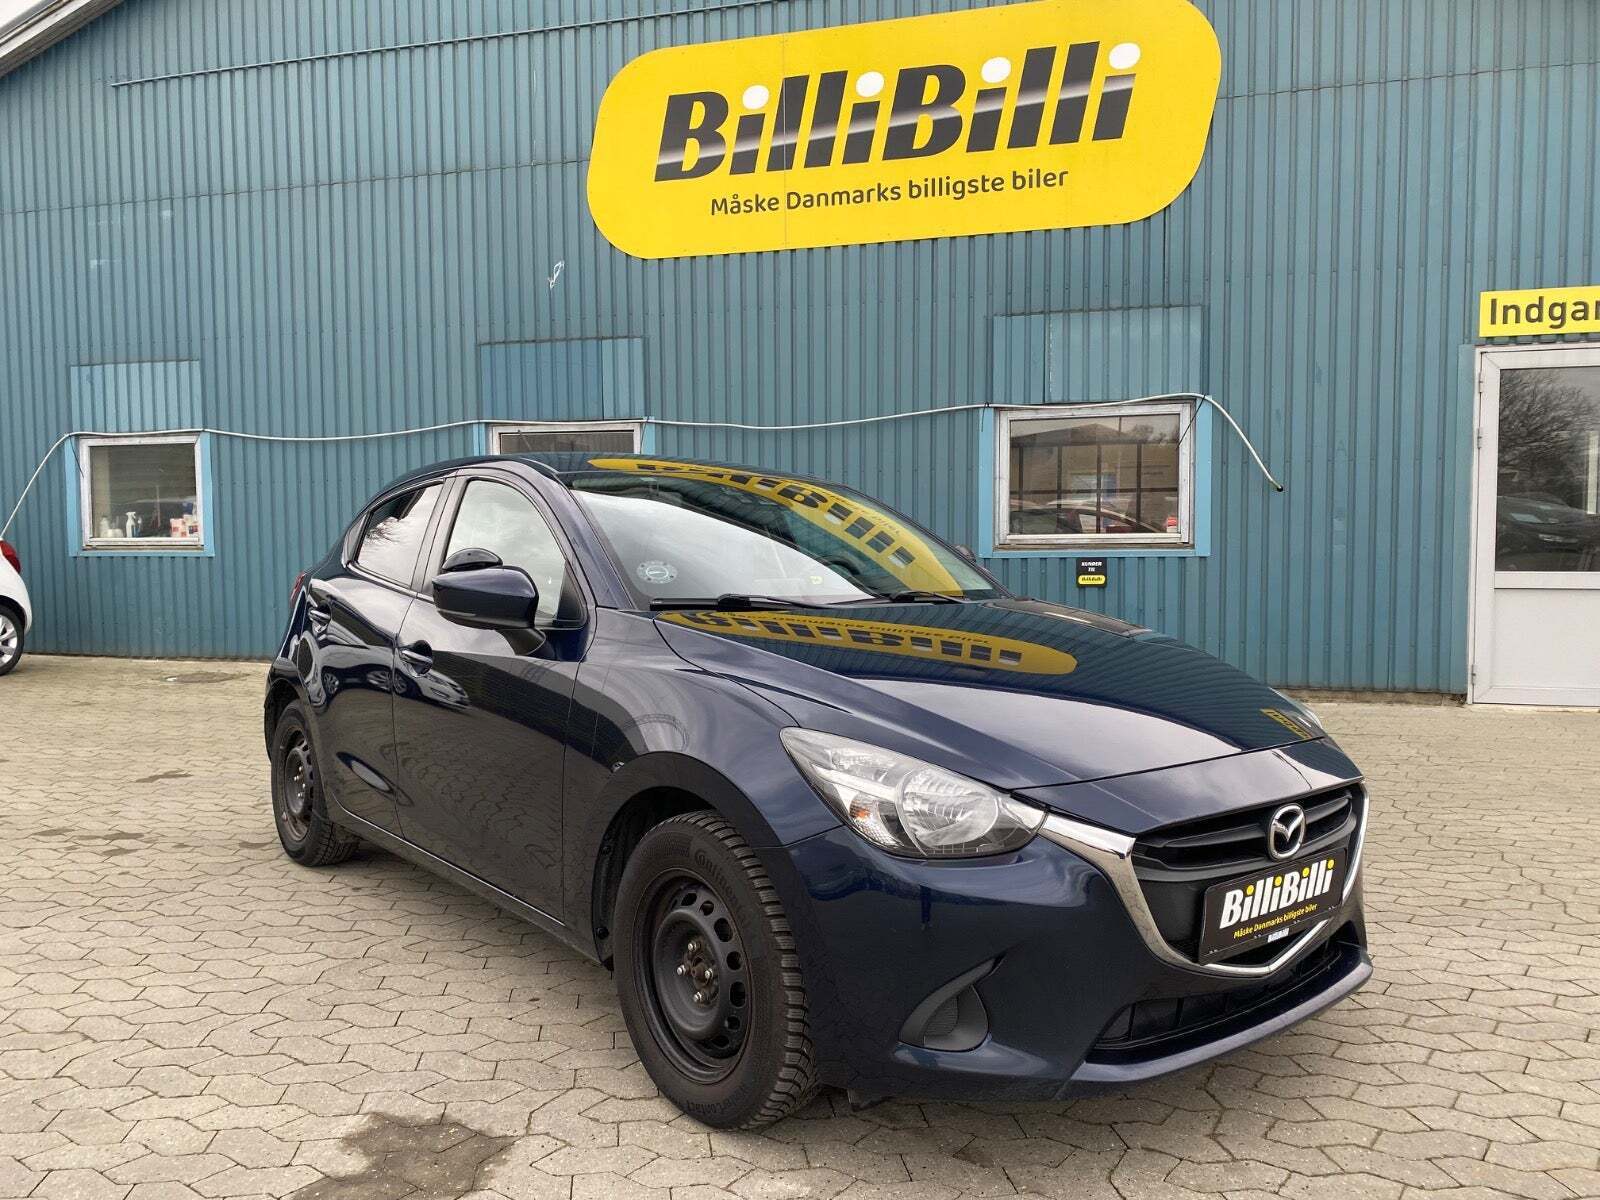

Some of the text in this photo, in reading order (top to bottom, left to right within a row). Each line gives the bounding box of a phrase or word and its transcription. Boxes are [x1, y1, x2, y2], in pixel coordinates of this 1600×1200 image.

[653, 41, 1141, 182] BilliBilli
[711, 168, 1069, 215] Måske Danmarks billigste biler
[1490, 295, 1600, 329] Indga
[1219, 859, 1335, 929] BilliBilli
[1254, 915, 1283, 932] Danmarks
